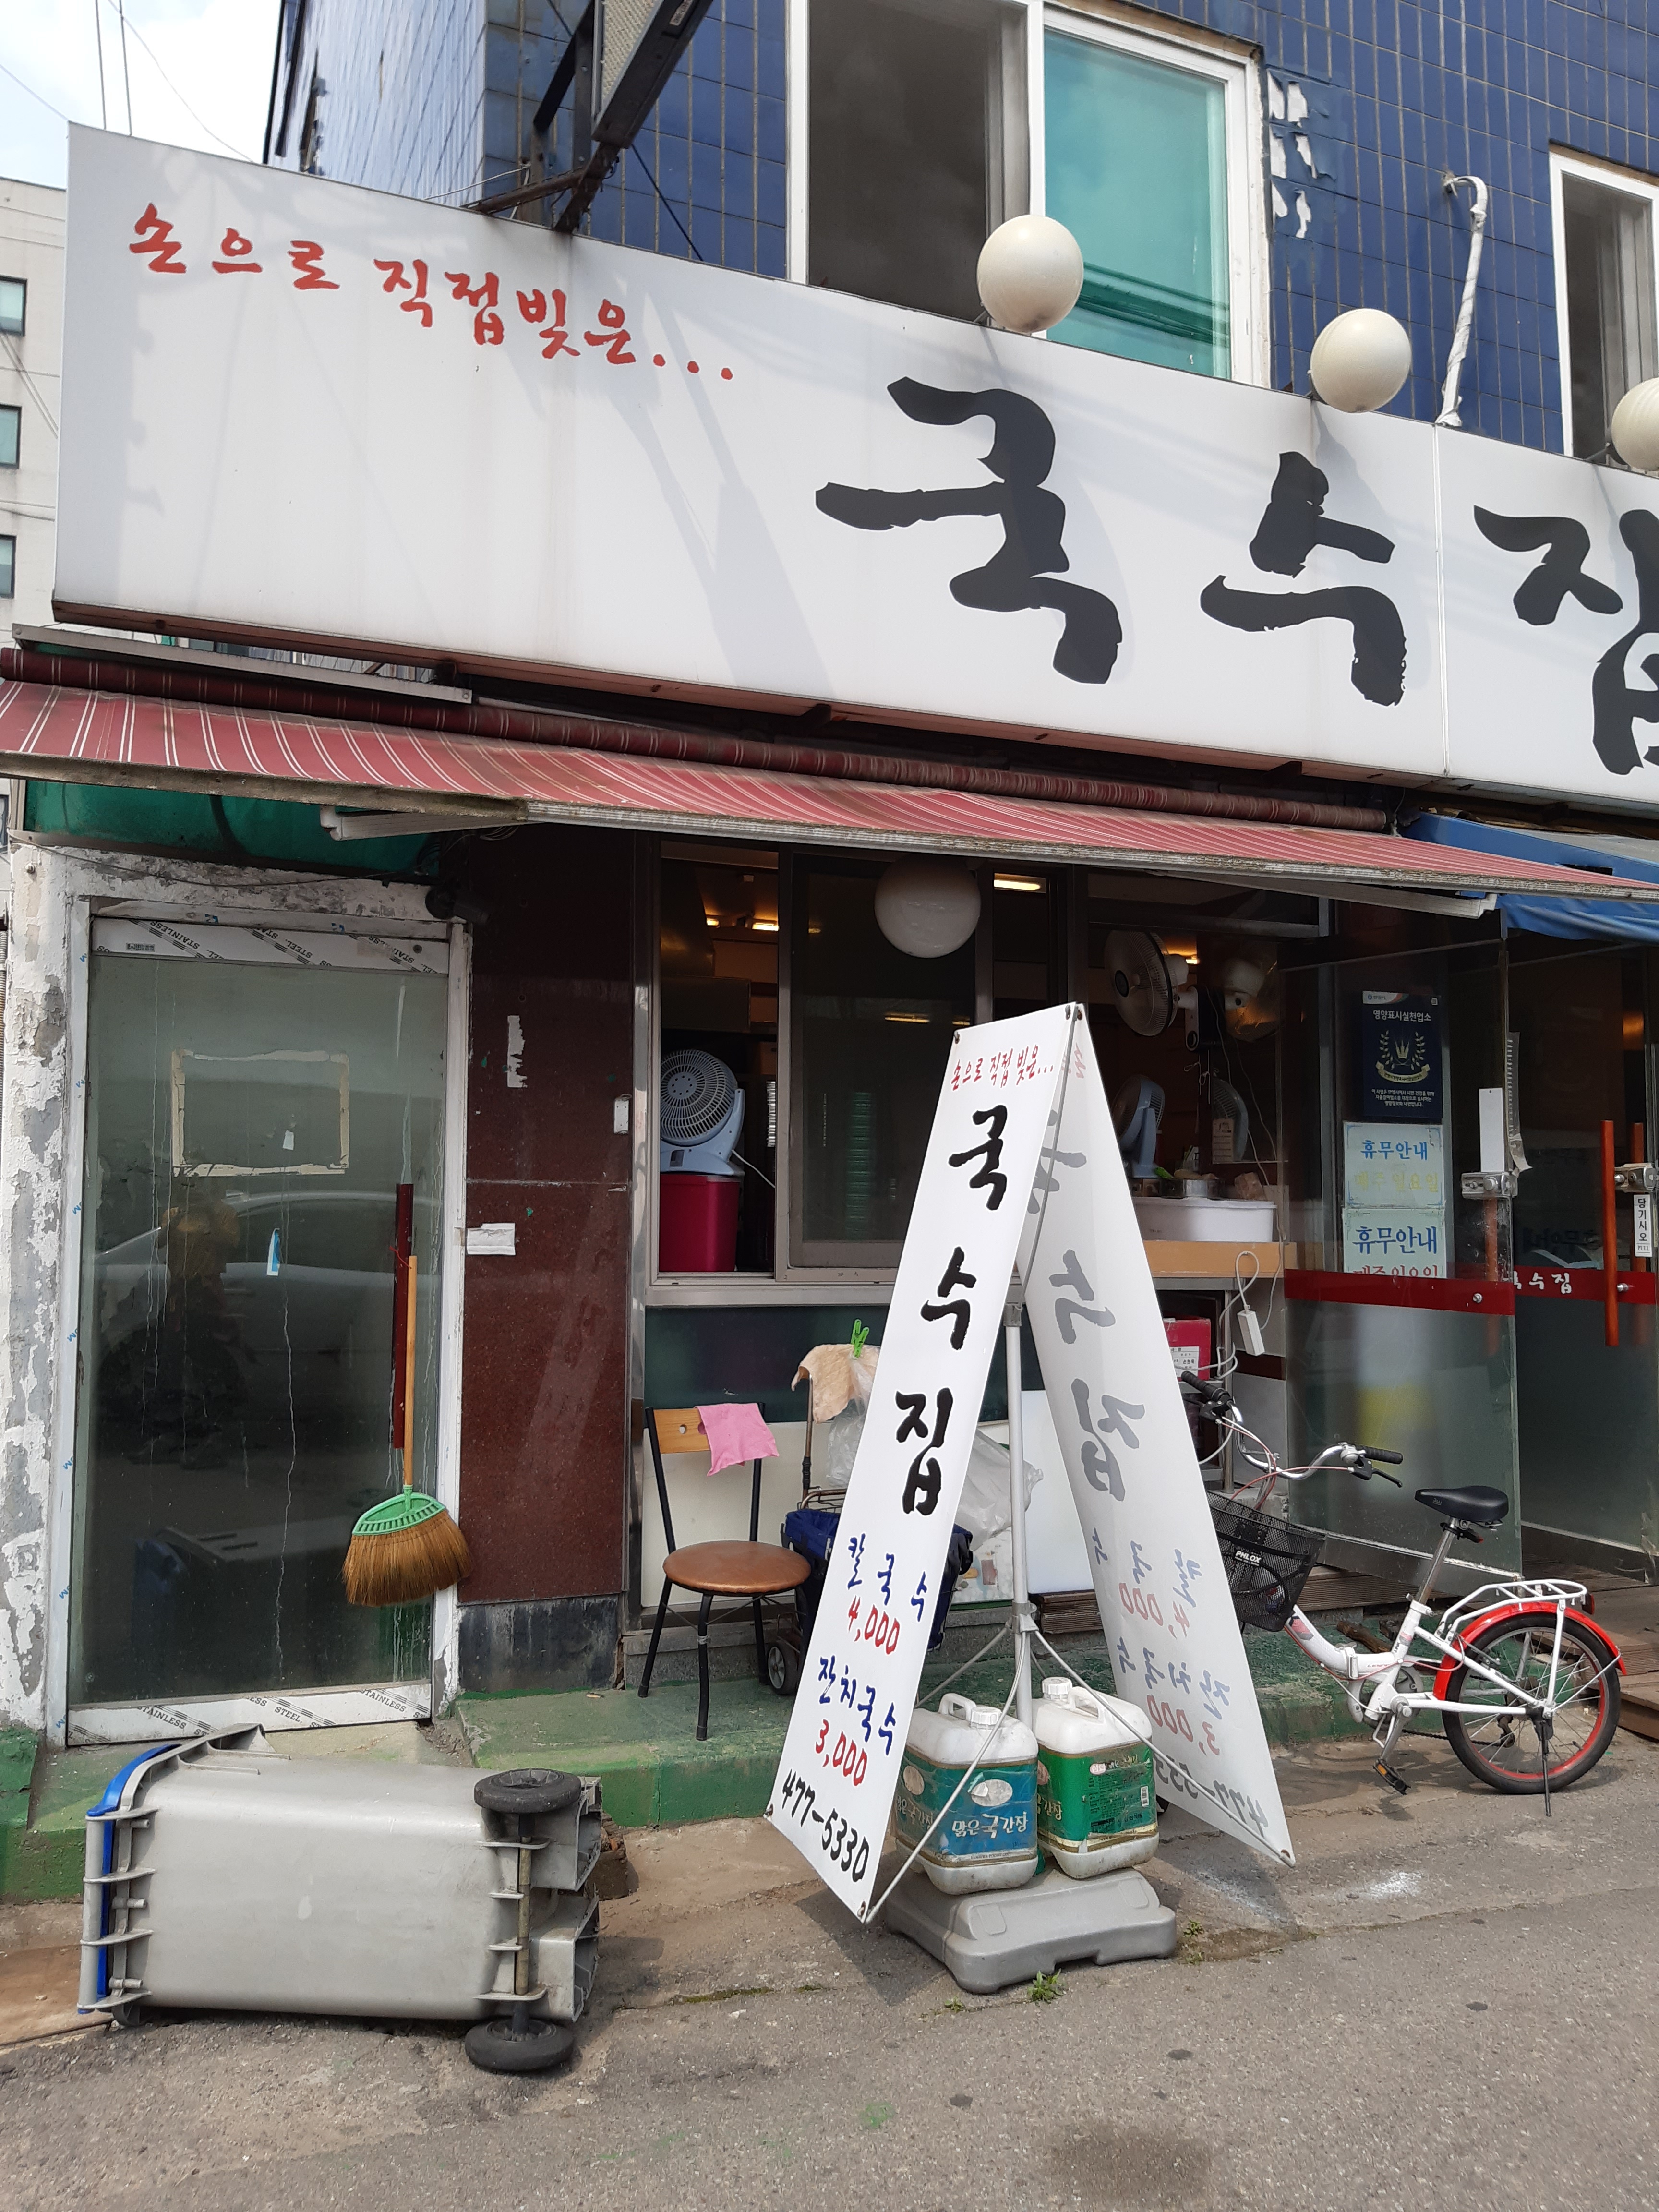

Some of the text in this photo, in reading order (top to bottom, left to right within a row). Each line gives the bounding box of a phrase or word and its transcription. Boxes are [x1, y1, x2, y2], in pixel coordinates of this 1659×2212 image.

[129, 203, 340, 290] 손으로
[1373, 1009, 1432, 1022] 영양표시실천업소
[950, 1058, 984, 1091] 손으로
[989, 1048, 1014, 1088] 직접
[1361, 1139, 1429, 1161] 휴무안내
[1352, 1226, 1437, 1255] 휴무안내
[1637, 1198, 1648, 1242] 당기시오
[1235, 1550, 1262, 1563] PHLOX
[848, 1597, 901, 1656] 4,000
[817, 1655, 896, 1755] 잔치국수
[815, 1719, 867, 1787] 3,000
[782, 1768, 870, 1883] 477-5330
